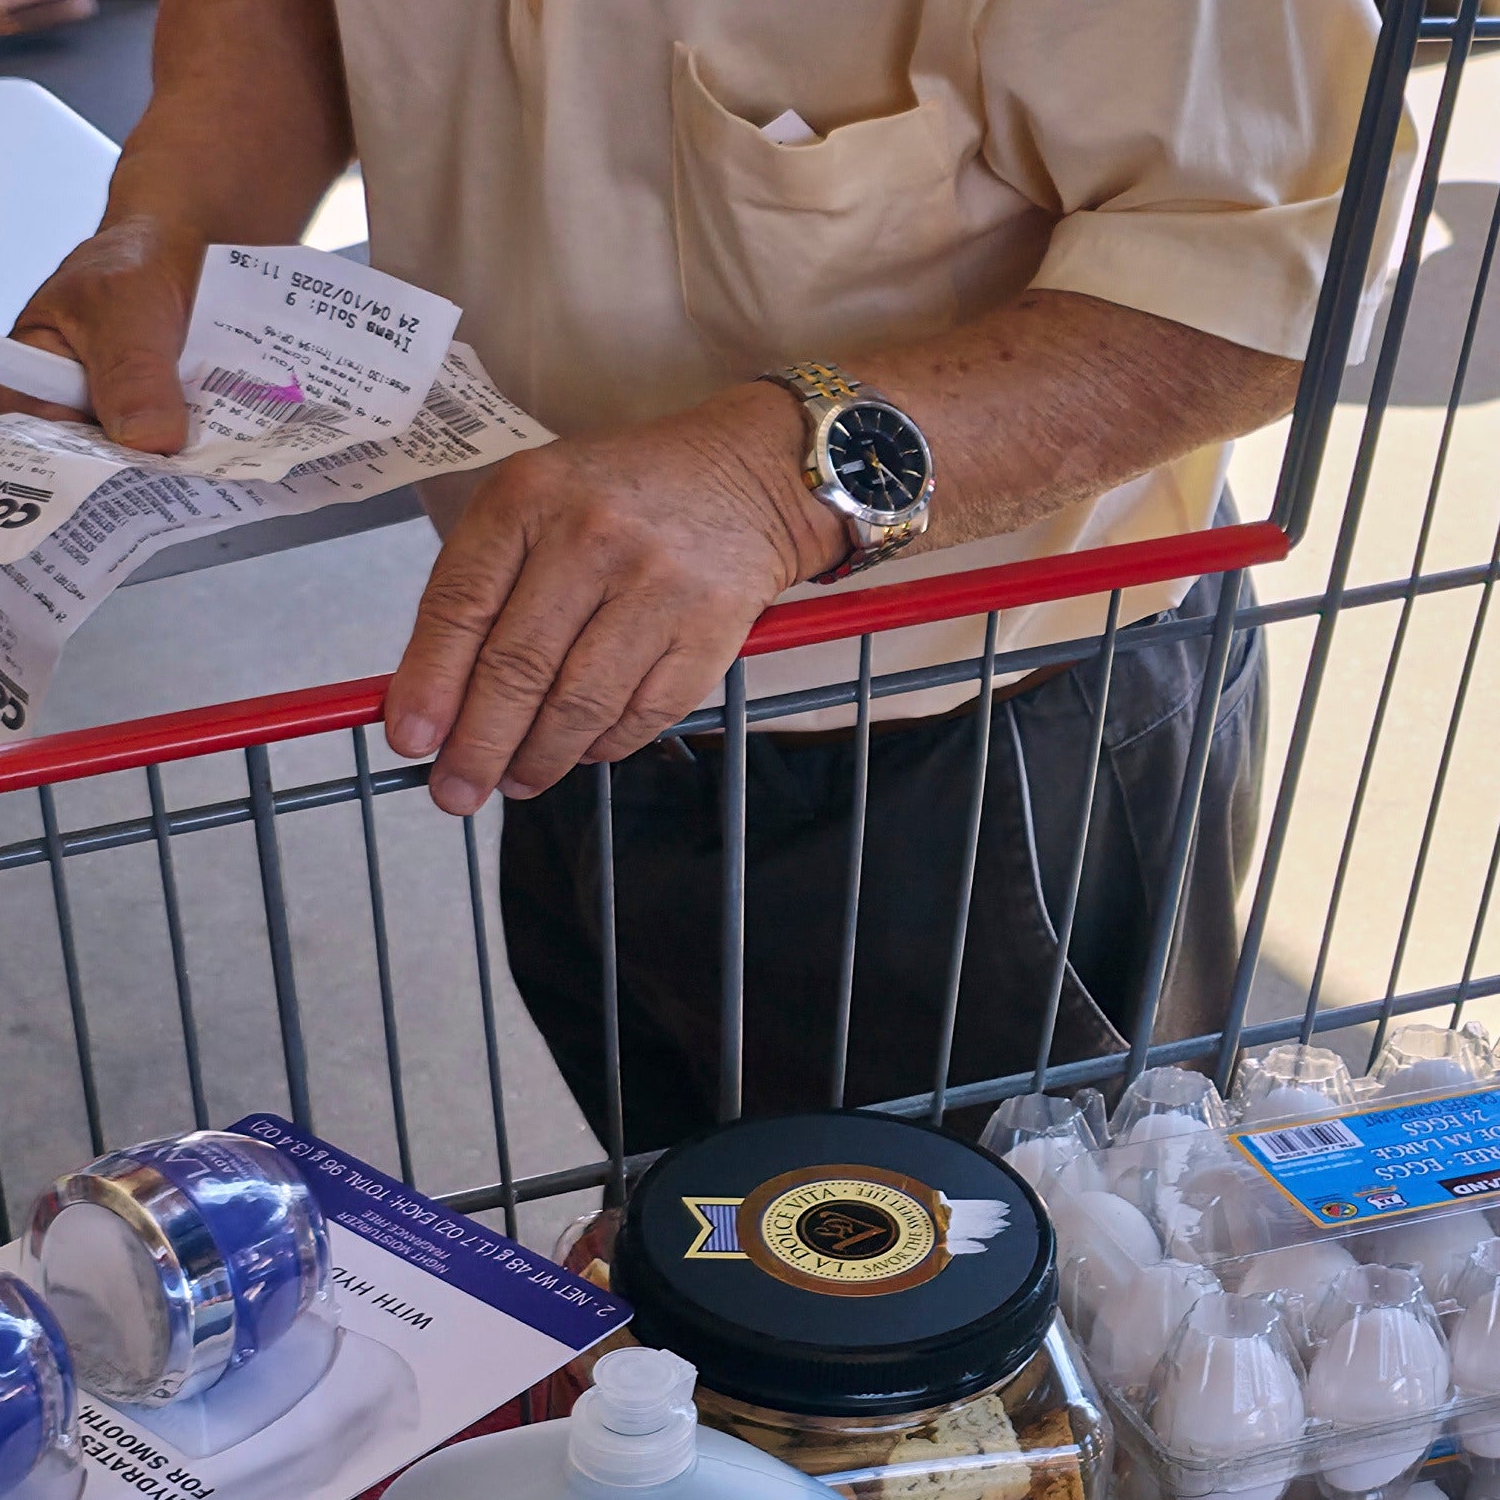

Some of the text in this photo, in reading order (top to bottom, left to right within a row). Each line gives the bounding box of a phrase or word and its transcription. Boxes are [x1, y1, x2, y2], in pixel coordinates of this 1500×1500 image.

[229, 248, 421, 334] 24 04/10/2025 11:36
[284, 290, 413, 354] Items Sold: 9
[1400, 1113, 1457, 1137] EGGS
[1441, 1130, 1473, 1147] AA
[1458, 1108, 1489, 1125] 24
[1369, 1137, 1444, 1160] LARGE
[1373, 1156, 1443, 1181] EGGS
[249, 1118, 617, 1317] 2 NET WT 48 g (1.7 OZ) EACH; TOTAL 96 g (3.4 OZ)
[335, 1210, 450, 1274] NIGHT MOISTURIZER
[359, 1208, 452, 1262] FRAGRANCE-FREE
[772, 1188, 844, 1273] LA DOLCE VITA
[370, 1292, 434, 1330] WITH
[74, 1403, 216, 1500] FOR SMOOTH,
